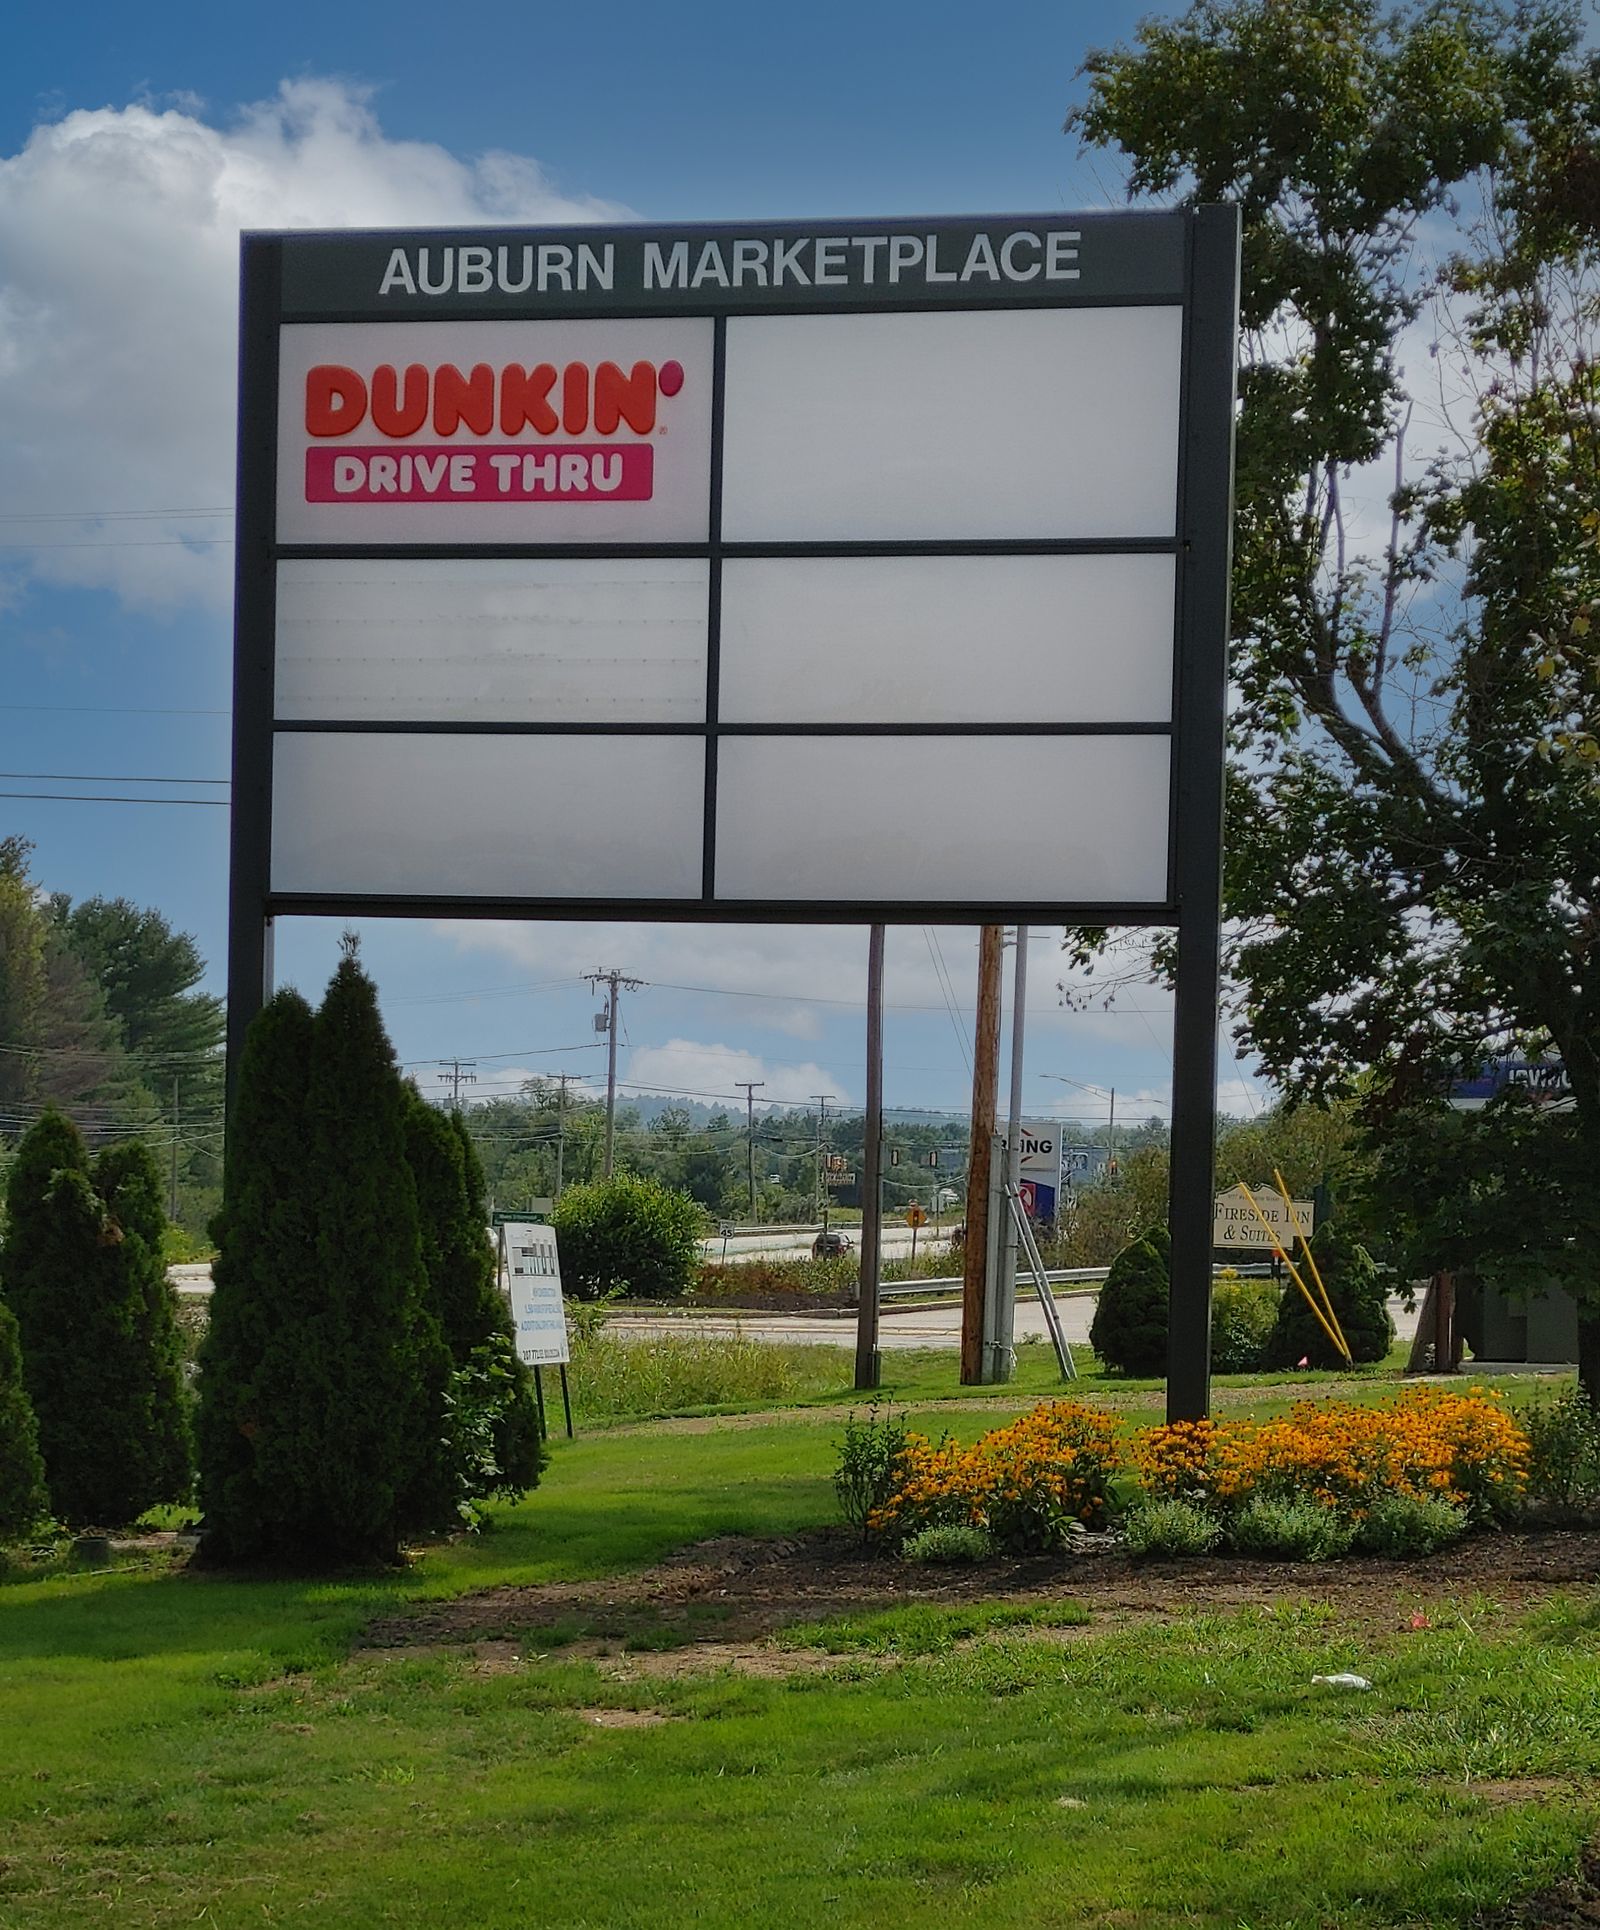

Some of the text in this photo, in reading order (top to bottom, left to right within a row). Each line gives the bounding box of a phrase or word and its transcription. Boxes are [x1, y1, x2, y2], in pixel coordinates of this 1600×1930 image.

[378, 231, 1082, 296] AUBURN MARKETPLACE
[304, 360, 685, 438] DUNKIN'
[333, 453, 623, 494] DRIVE THRU
[1214, 1203, 1279, 1223] FIRESDE
[720, 1229, 733, 1237] 45
[1223, 1224, 1236, 1240] &
